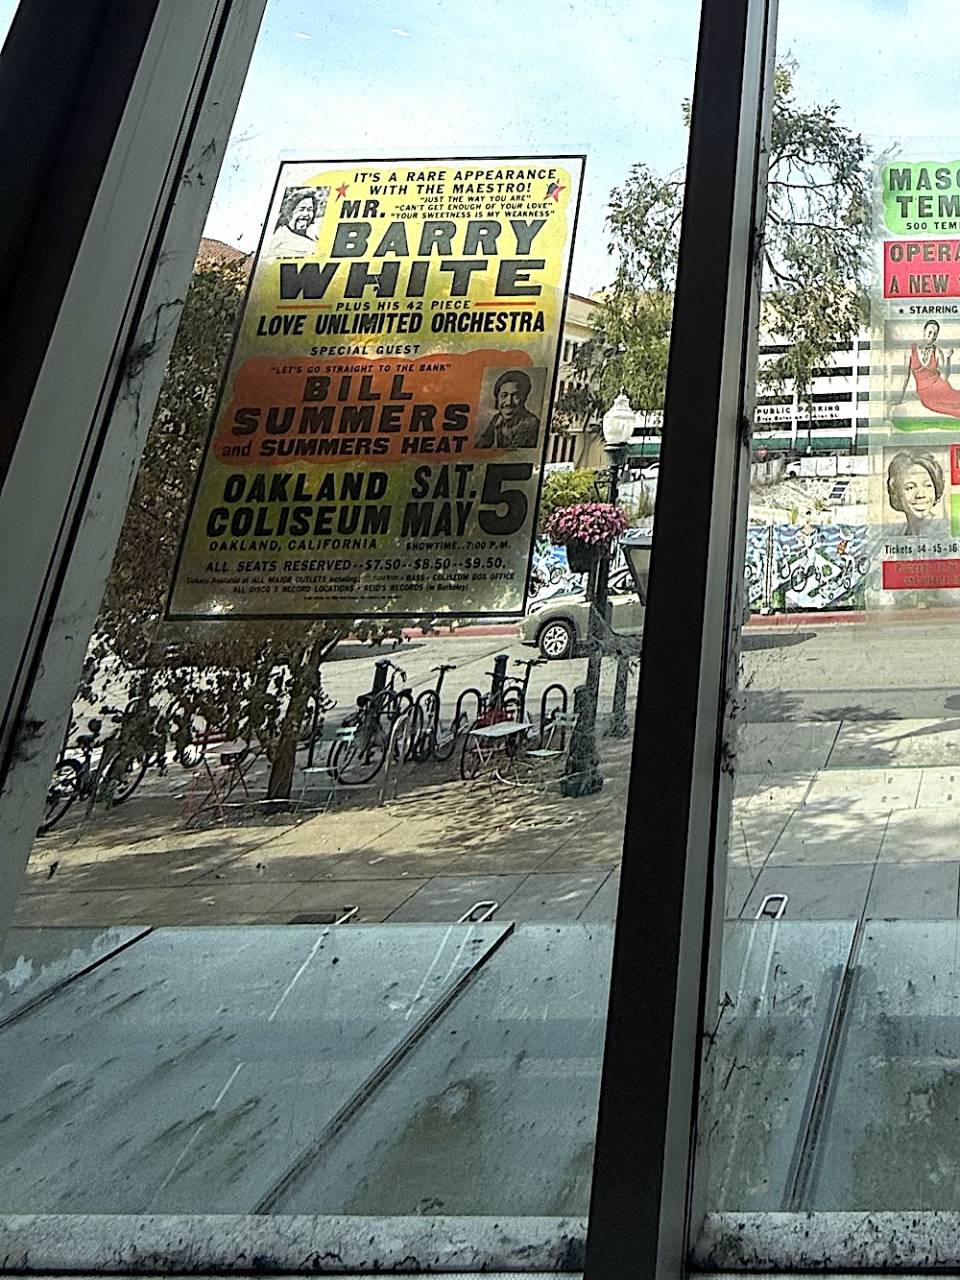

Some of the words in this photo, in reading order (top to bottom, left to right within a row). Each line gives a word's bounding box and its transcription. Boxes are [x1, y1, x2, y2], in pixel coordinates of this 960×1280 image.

[354, 172, 381, 183] IT'S
[388, 172, 398, 182] A
[406, 171, 447, 182] RARE
[453, 169, 557, 181] APPEARANCE
[369, 185, 408, 196] WITH
[416, 184, 445, 195] THE
[453, 182, 532, 194] MAESTRO!
[340, 200, 386, 219] MR.
[906, 222, 928, 230] 500
[330, 219, 547, 258] BARRY
[279, 259, 546, 300] WHITE
[889, 275, 899, 294] A
[909, 274, 949, 293] NEW
[336, 301, 372, 312] PLUS
[376, 301, 401, 310] HIS
[406, 301, 424, 310] 42
[430, 300, 472, 310] PIECE
[909, 305, 958, 314] STARRING
[256, 315, 307, 337] LOVE
[314, 313, 422, 335] UNLIMITED
[431, 311, 545, 333] ORCHESTRA
[310, 345, 369, 356] SPECIAL
[375, 344, 421, 355] GUEST
[302, 375, 414, 402] BILL
[232, 404, 471, 436] SUMMERS
[222, 441, 252, 457] and
[260, 436, 390, 457] SUMMERS
[401, 436, 468, 454] HEAT
[223, 472, 388, 503] OAKLAND
[412, 465, 476, 499] SAT.
[478, 463, 533, 535] 5
[207, 505, 392, 537] COLISEUM
[401, 501, 474, 537] MAY
[209, 541, 281, 552] OAKLAND,
[288, 538, 377, 550] CALIFORNIA
[884, 545, 913, 555] Tickets
[206, 562, 229, 572] ALL
[238, 561, 276, 571] SEATS
